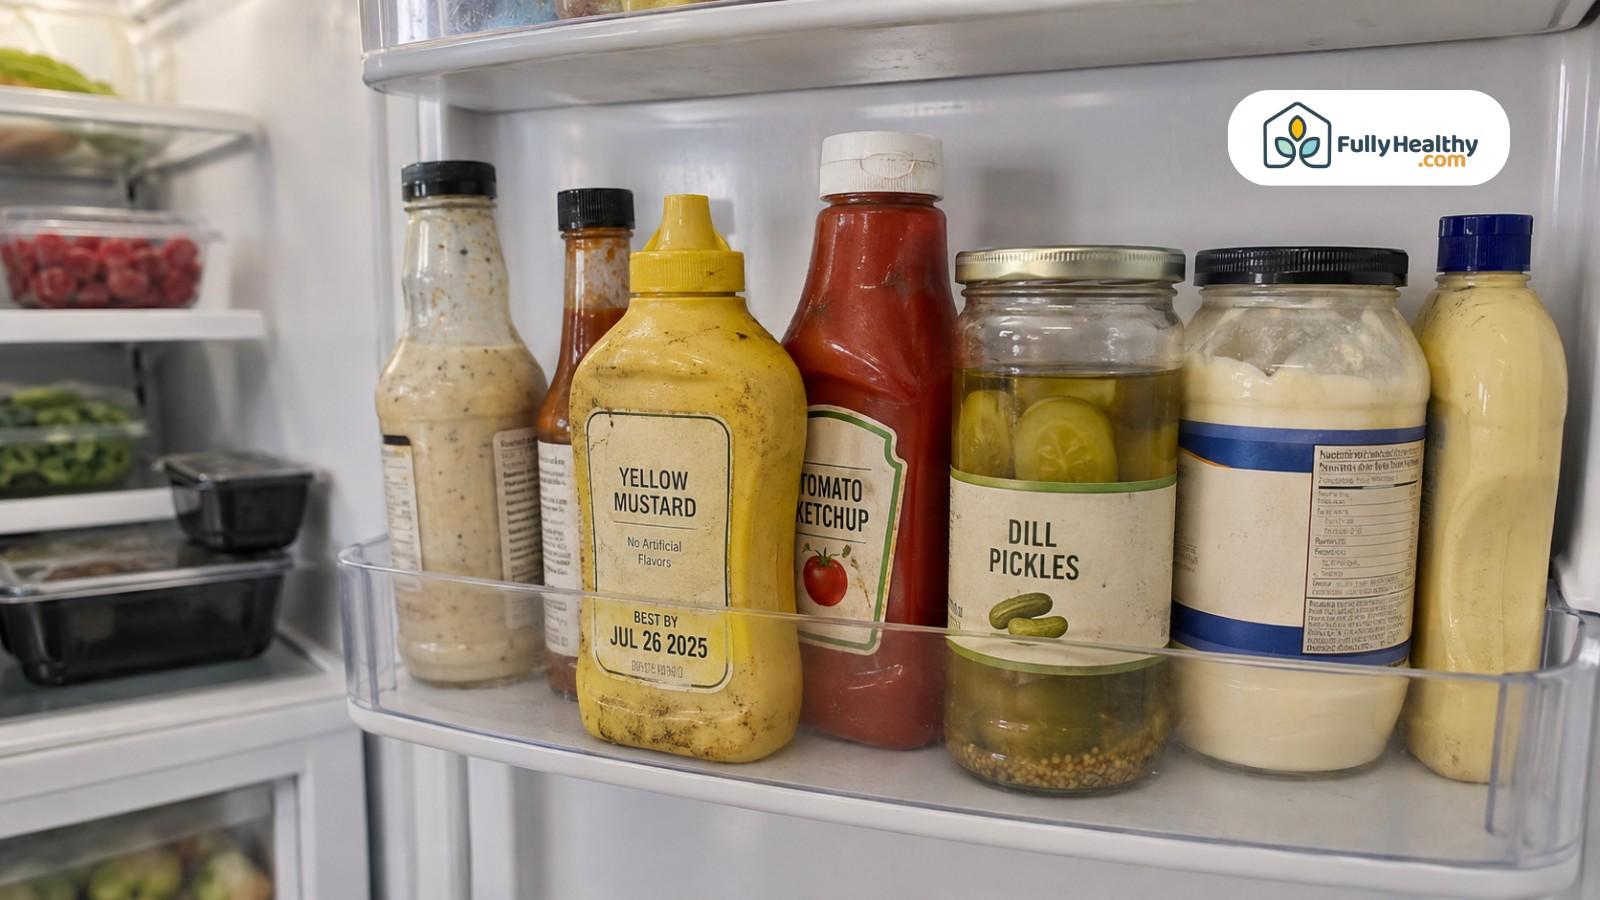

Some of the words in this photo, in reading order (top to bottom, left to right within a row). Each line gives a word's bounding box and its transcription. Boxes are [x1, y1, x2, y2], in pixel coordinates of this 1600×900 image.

[619, 466, 688, 491] YELLOW
[800, 473, 862, 503] TOMATO
[614, 492, 697, 518] MUSTARD
[796, 500, 869, 532] KETCHUP
[627, 536, 640, 548] No
[642, 538, 682, 553] Artificial
[1008, 518, 1057, 548] DILL
[638, 553, 672, 568] Flavors
[989, 547, 1080, 581] PICKLES
[633, 610, 661, 626] BEST
[663, 614, 679, 628] BY
[610, 625, 638, 649] JUL
[643, 630, 661, 653] 26
[667, 633, 708, 659] 2025
